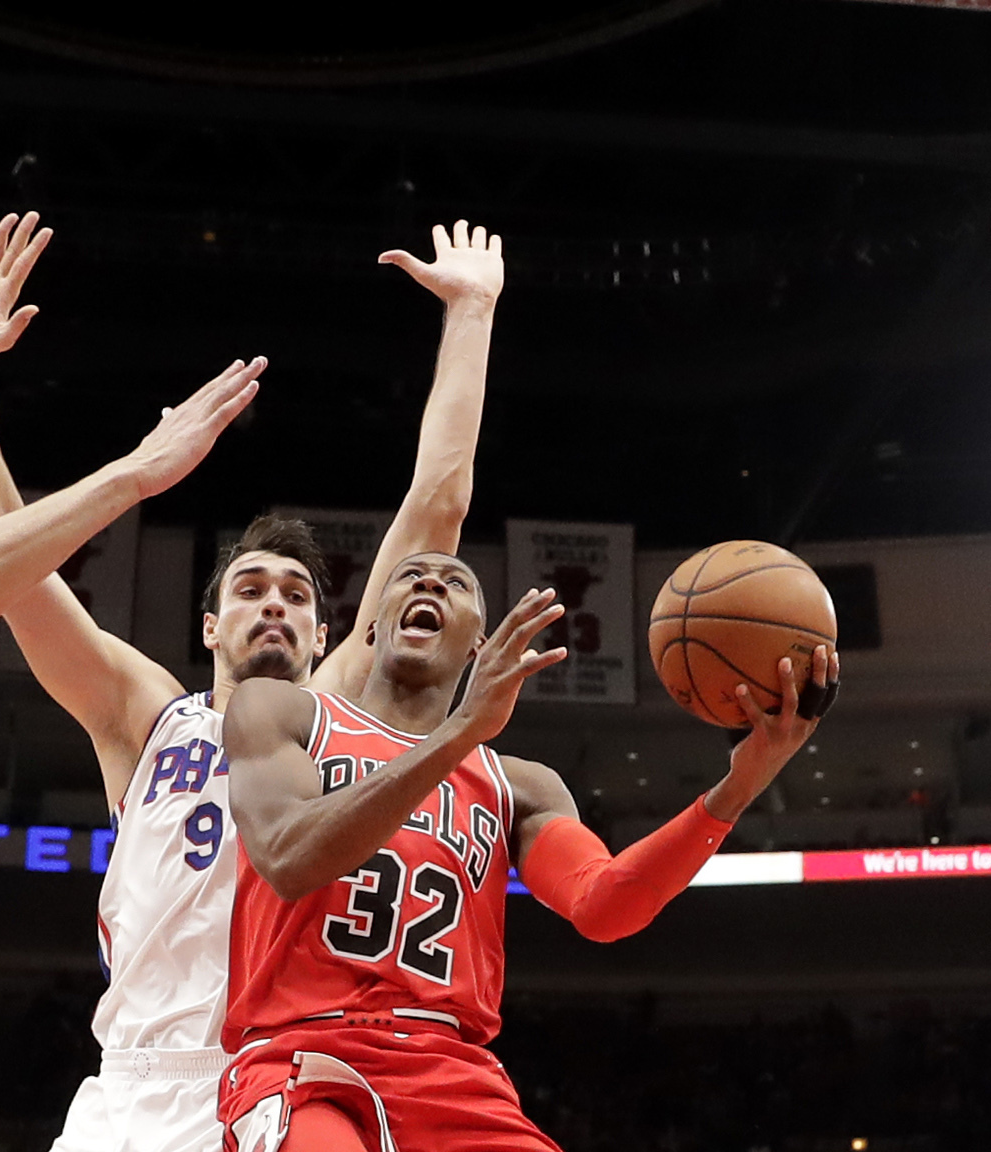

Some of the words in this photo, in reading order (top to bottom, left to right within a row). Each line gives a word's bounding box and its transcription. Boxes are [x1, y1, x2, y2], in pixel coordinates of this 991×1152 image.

[184, 801, 224, 873] 9
[319, 755, 501, 894] BLS
[863, 851, 919, 874] We're
[922, 850, 969, 872] here
[321, 848, 465, 987] 32
